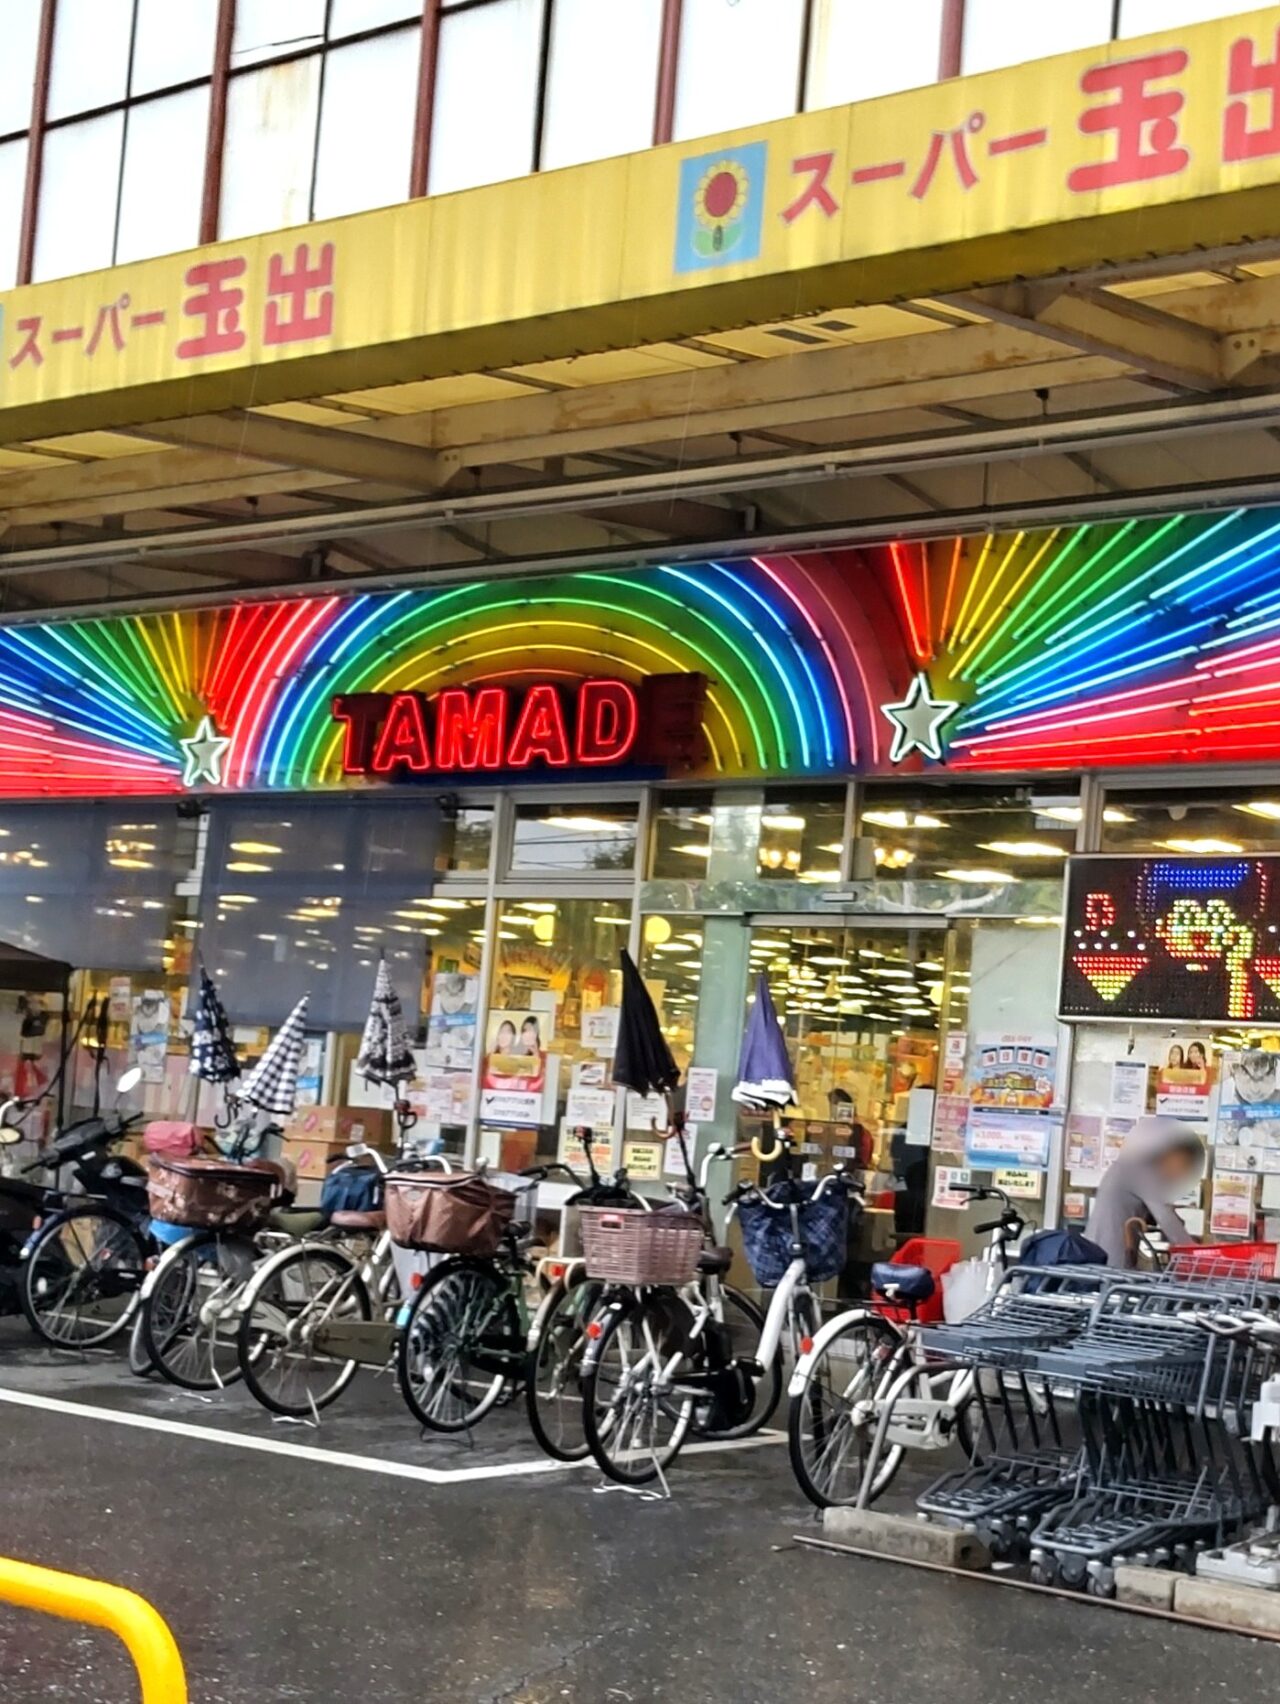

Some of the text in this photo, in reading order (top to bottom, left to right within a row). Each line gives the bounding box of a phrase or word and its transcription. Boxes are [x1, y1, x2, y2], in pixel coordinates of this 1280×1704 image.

[9, 241, 335, 370] スーパー玉出
